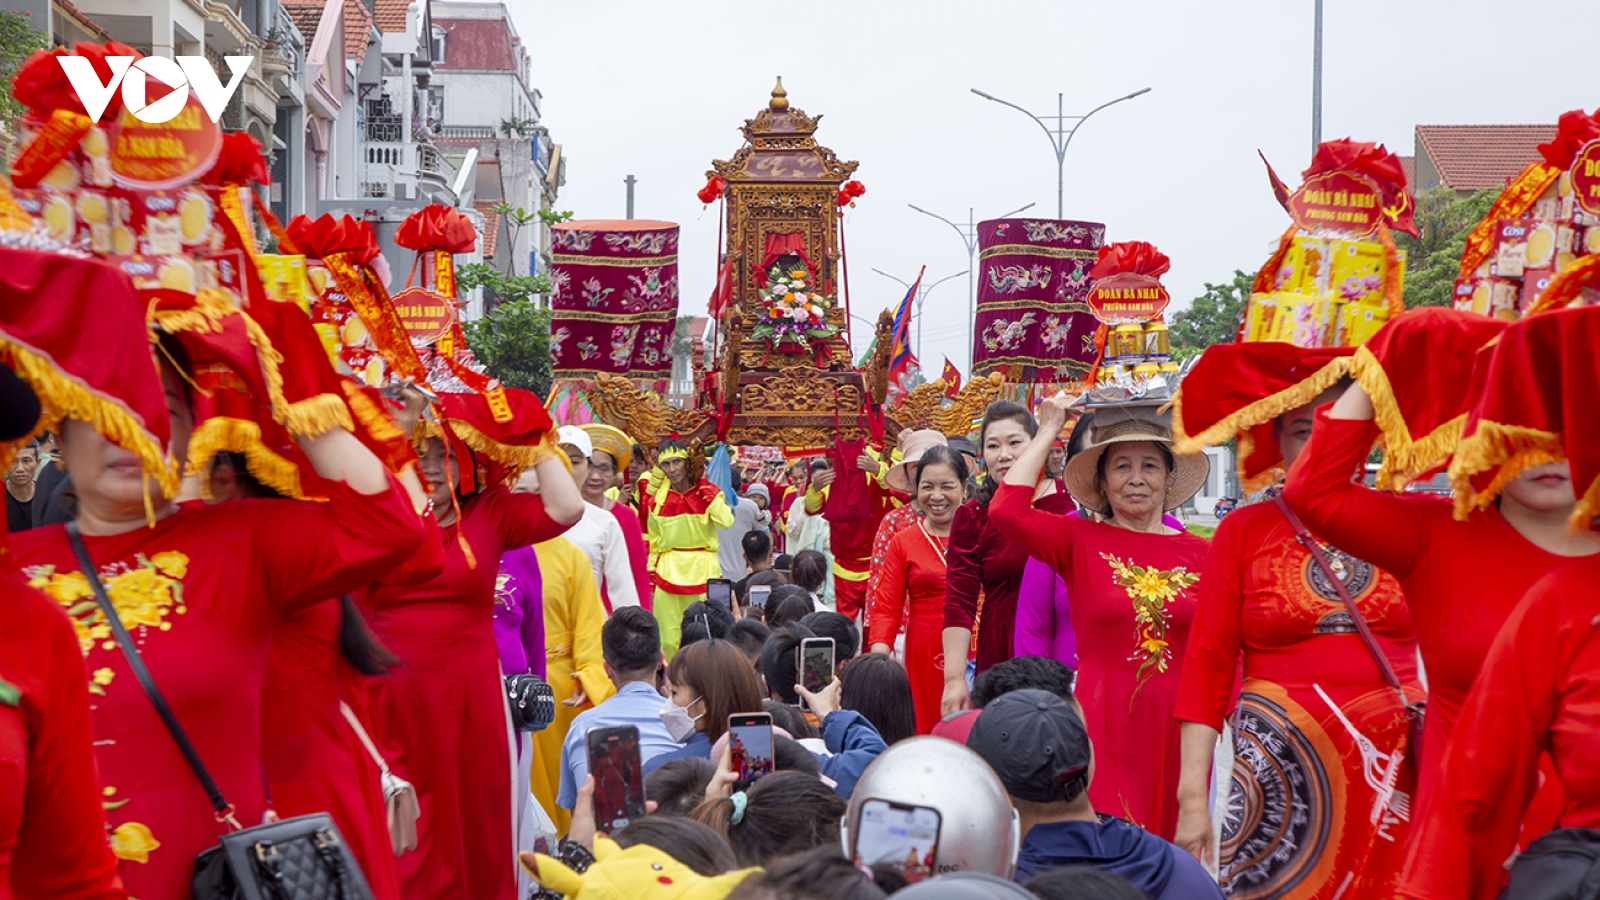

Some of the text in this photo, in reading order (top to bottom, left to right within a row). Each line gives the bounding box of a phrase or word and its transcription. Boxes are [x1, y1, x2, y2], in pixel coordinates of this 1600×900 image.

[1333, 188, 1348, 208] BÀ
[1349, 192, 1376, 209] NHAI
[1123, 287, 1136, 299] BÀ
[1137, 288, 1159, 299] NHAI
[1128, 303, 1140, 311] NAM
